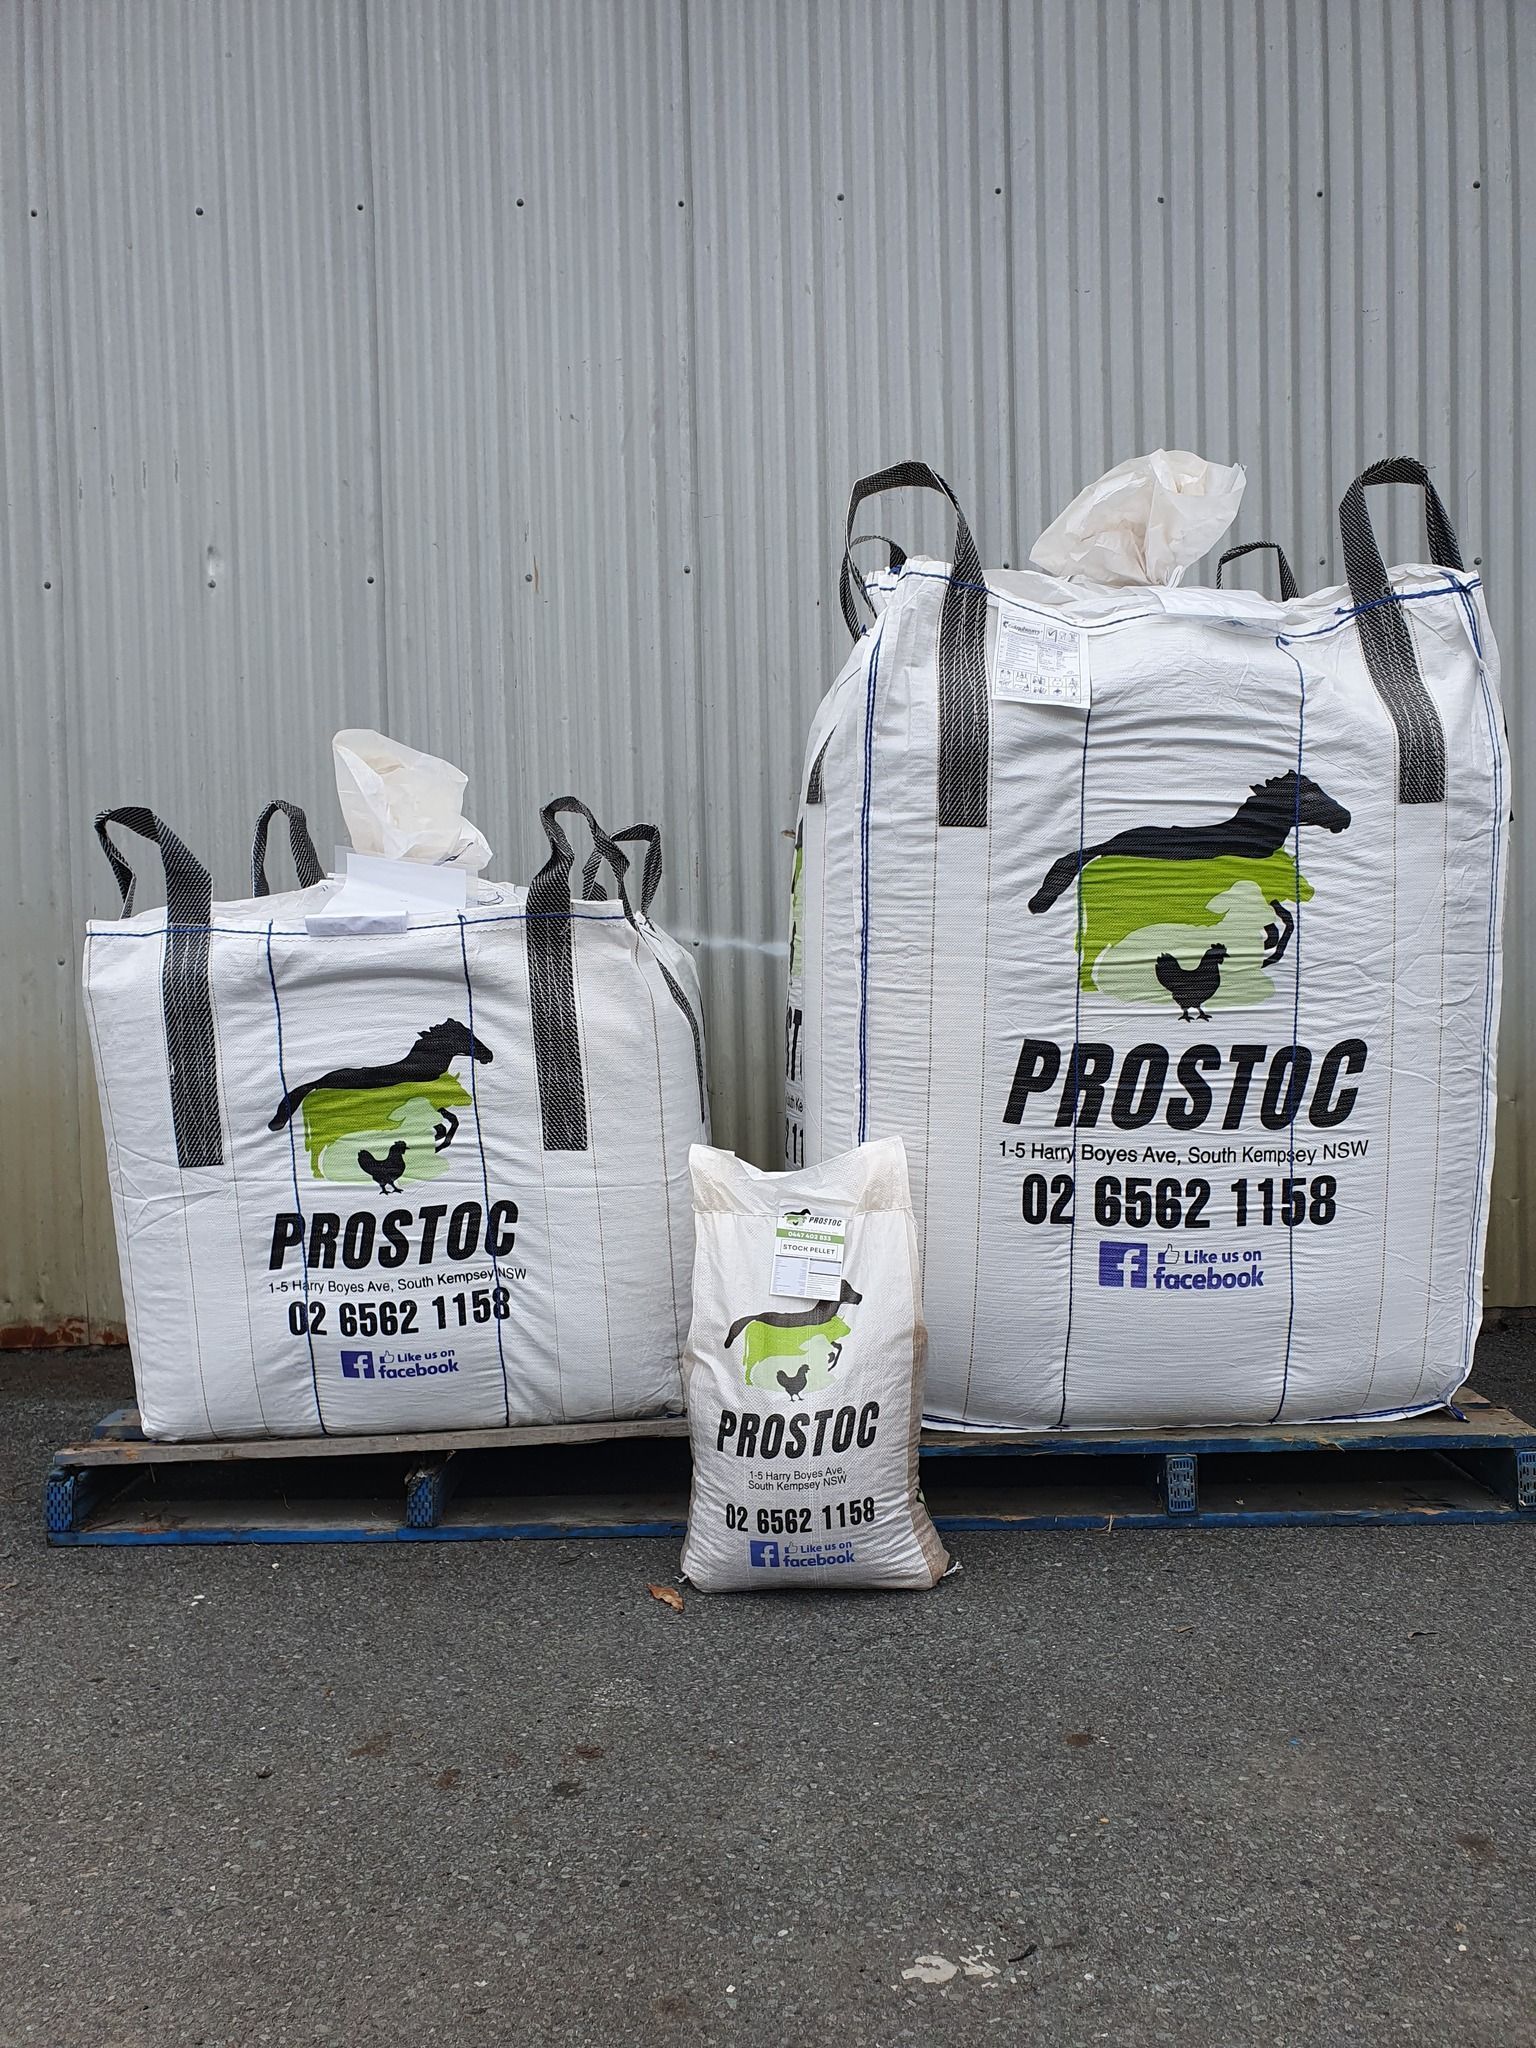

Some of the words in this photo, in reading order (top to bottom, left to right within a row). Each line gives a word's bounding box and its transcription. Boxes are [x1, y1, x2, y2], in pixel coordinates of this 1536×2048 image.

[1002, 1038, 1368, 1130] PROSTOC
[1000, 1141, 1026, 1158] 1-5
[1031, 1143, 1075, 1164] Harry
[1082, 1144, 1138, 1167] Boyes
[1142, 1146, 1181, 1166] Ave,
[1188, 1146, 1236, 1163] South
[1242, 1145, 1317, 1167] Kempsey
[1323, 1140, 1369, 1160] NSW
[1022, 1173, 1074, 1225] 02
[1094, 1175, 1211, 1229] 6562
[1231, 1175, 1337, 1226] 1158
[269, 1200, 519, 1271] PROSTOC
[783, 1244, 808, 1252] STOCK
[809, 1246, 835, 1255] PELLET
[1184, 1250, 1218, 1264] Like
[1221, 1252, 1239, 1262] us
[1242, 1250, 1262, 1262] on
[269, 1281, 288, 1293] 1-5
[293, 1280, 324, 1294] Harry
[328, 1280, 364, 1295] Boyes
[367, 1280, 394, 1293] Ave,
[398, 1276, 433, 1291] South
[437, 1269, 494, 1286] Kempsey
[498, 1267, 527, 1280] NSW
[1153, 1264, 1265, 1290] facebook
[288, 1301, 328, 1336] 02
[339, 1300, 419, 1337] 6562
[432, 1287, 511, 1330] 1158
[378, 1359, 459, 1379] facebook
[397, 1352, 422, 1363] Like
[425, 1352, 438, 1360] us
[440, 1350, 455, 1358] on
[716, 1401, 880, 1460] PROSTOC
[748, 1480, 774, 1490] South
[777, 1480, 821, 1492] Kempsey
[823, 1475, 847, 1487] NSW
[749, 1471, 763, 1480] 1-5
[765, 1471, 791, 1482] Harry
[794, 1471, 823, 1482] Boyes
[725, 1503, 748, 1532] 02
[757, 1508, 812, 1534] 6562
[822, 1497, 875, 1530] 1158
[783, 1551, 855, 1567] facebook
[801, 1544, 822, 1554] Like
[824, 1543, 836, 1551] us
[838, 1541, 852, 1549] on
